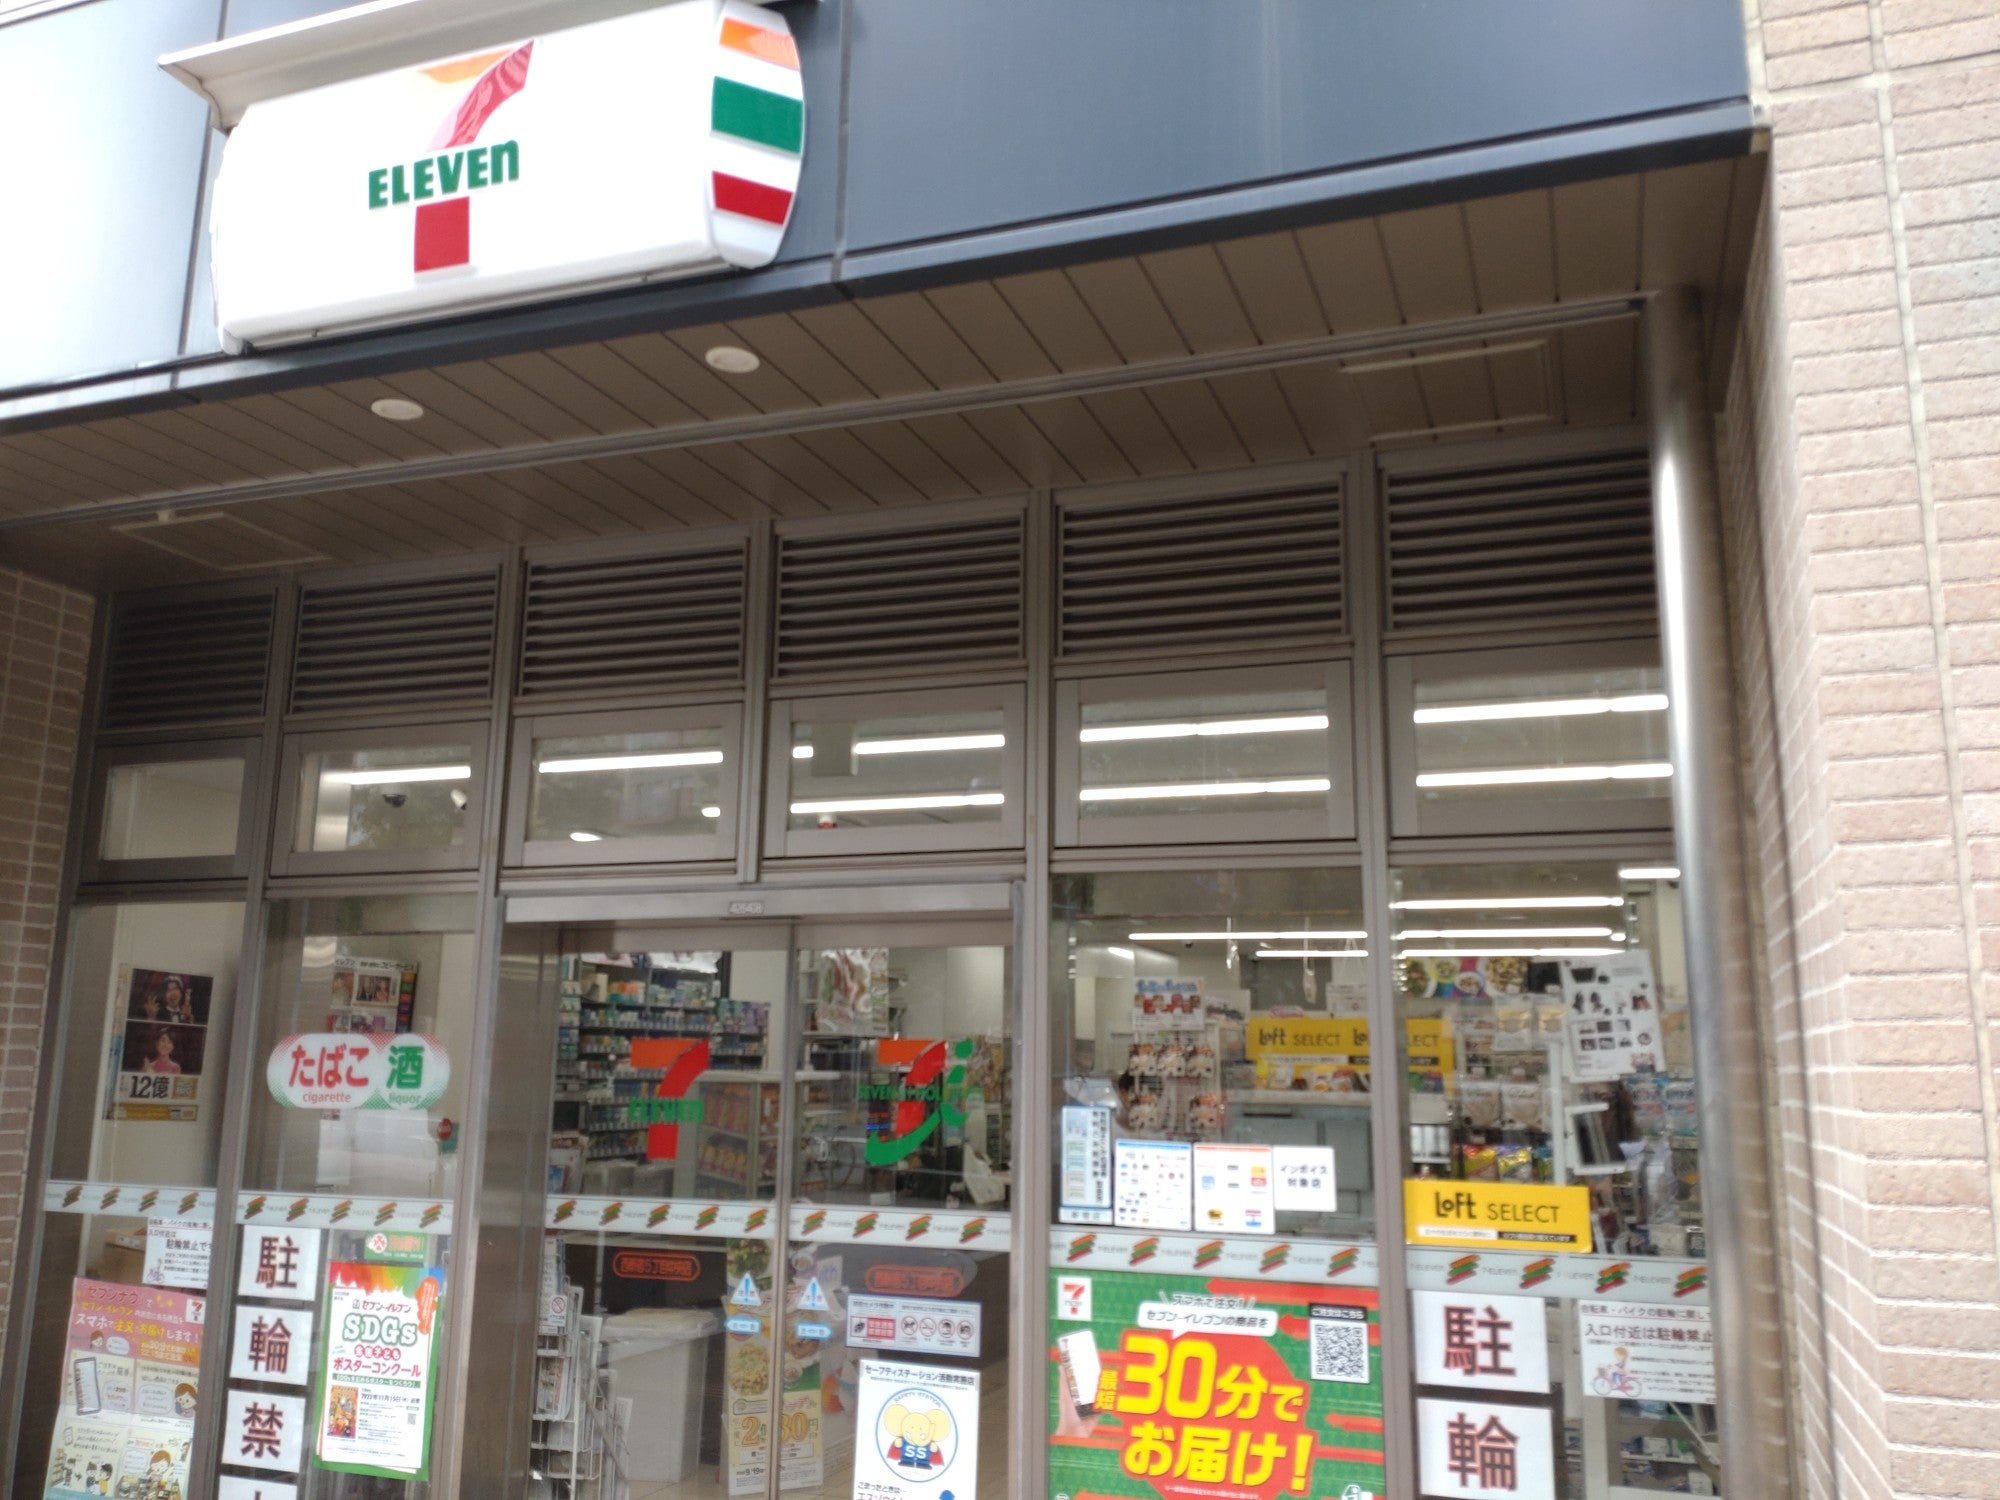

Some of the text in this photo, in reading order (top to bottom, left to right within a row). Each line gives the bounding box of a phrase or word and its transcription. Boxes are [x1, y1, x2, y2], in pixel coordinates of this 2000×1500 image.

[1292, 1033, 1341, 1047] SELECT
[1407, 1033, 1439, 1047] LECT
[288, 1043, 426, 1090] たばこ 酒
[129, 1075, 170, 1098] 12億
[302, 1090, 422, 1106] cigarette liquor
[1487, 1203, 1560, 1224] SELECT
[342, 1312, 418, 1347] SDGs
[1095, 1369, 1120, 1411] 最短
[1116, 1335, 1305, 1423] 30分で
[904, 1445, 928, 1460] SS
